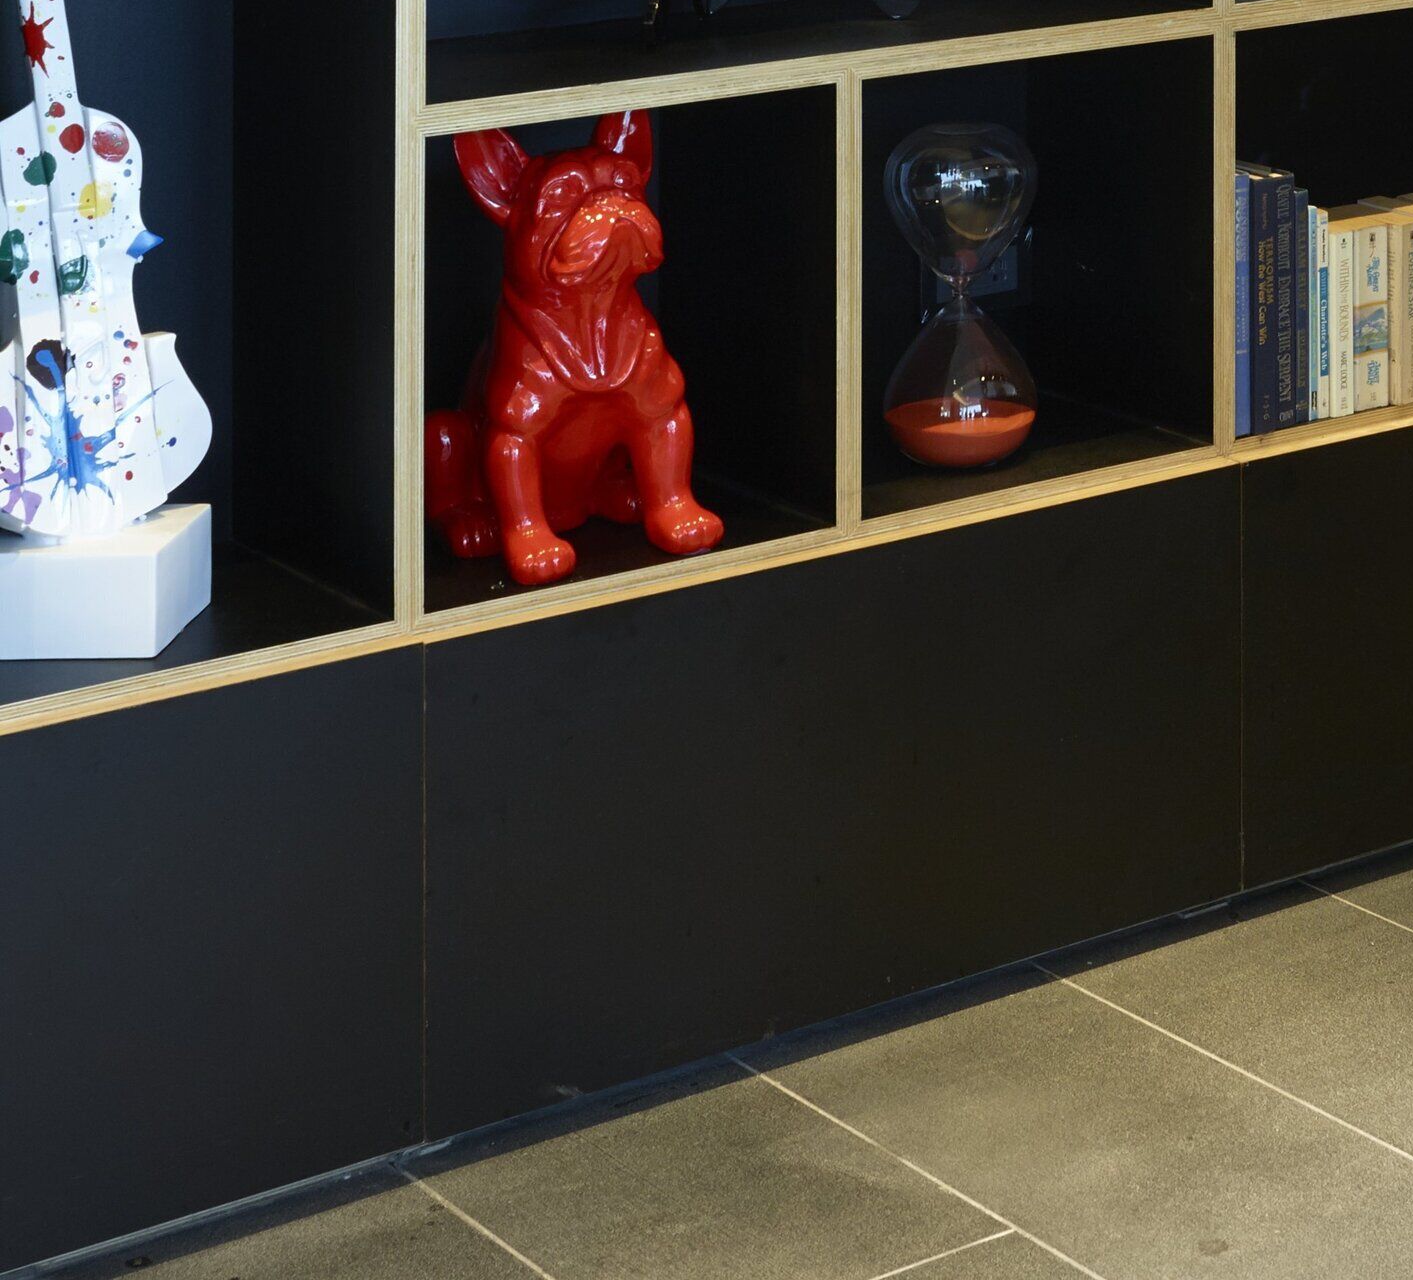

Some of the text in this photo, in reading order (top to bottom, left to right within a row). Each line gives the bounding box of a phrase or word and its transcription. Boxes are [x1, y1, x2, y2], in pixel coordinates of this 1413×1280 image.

[1258, 241, 1268, 347] How the West Can Win
[1266, 237, 1275, 305] TERRORISM
[1277, 276, 1292, 329] EMBRACE
[1339, 257, 1350, 342] WITHIN BOUNDS
[1320, 298, 1328, 371] Charlotte's Web
[1277, 353, 1291, 403] SERPENT
